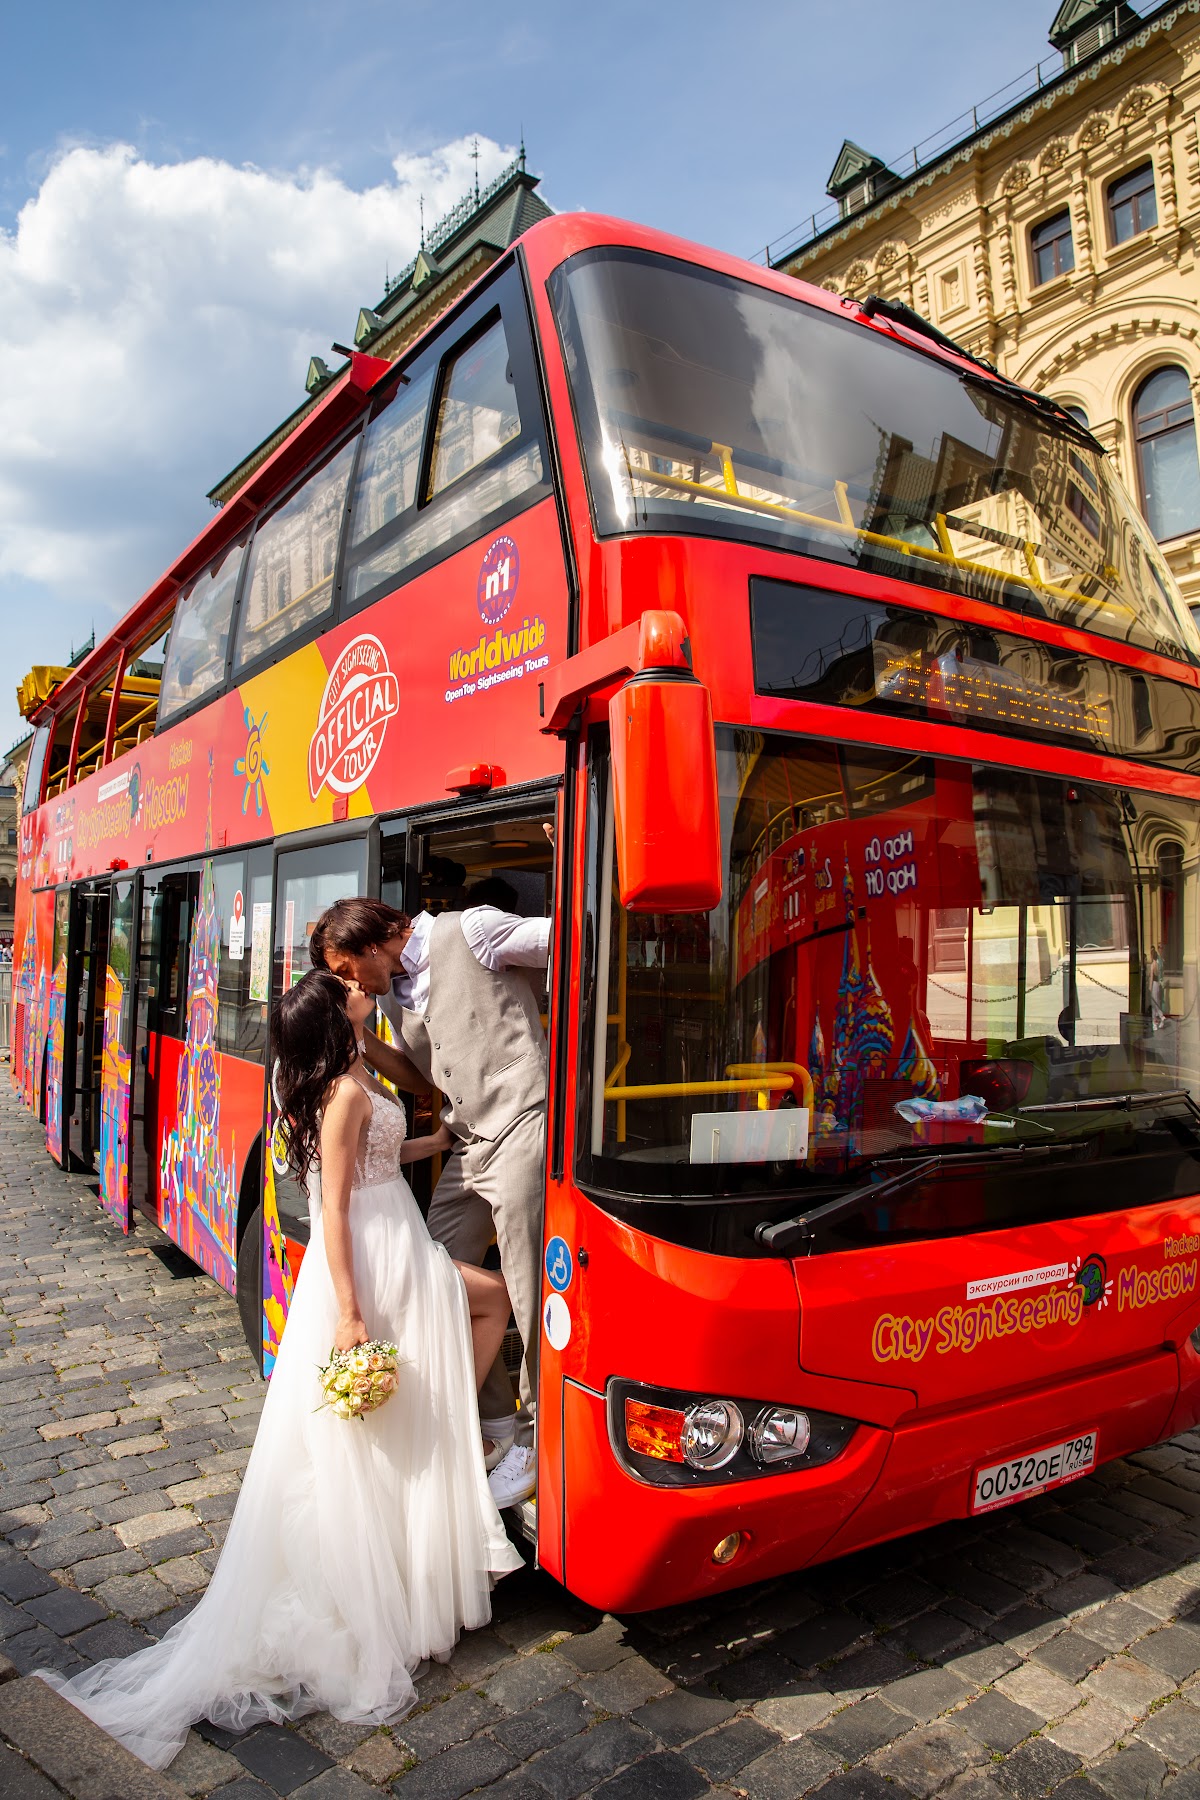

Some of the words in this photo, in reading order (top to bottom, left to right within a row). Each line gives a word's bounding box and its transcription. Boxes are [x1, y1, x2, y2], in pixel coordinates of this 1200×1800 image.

[481, 602, 511, 625] Operator
[449, 617, 546, 681] Worldwide
[328, 673, 340, 706] CITY
[341, 644, 381, 680] SIGHTSEEING
[477, 665, 524, 690] Sightseeing
[524, 655, 549, 673] Tours
[315, 679, 395, 777] OFFICIAL
[343, 732, 378, 780] TOUR
[143, 773, 189, 831] Moscow
[1164, 1233, 1200, 1259] Москва
[969, 1276, 1020, 1294] экскурсии
[1022, 1273, 1034, 1284] по
[1035, 1265, 1067, 1281] городу
[1118, 1258, 1198, 1312] Moscow
[1065, 1435, 1093, 1464] 799
[1068, 1459, 1083, 1471] RUS
